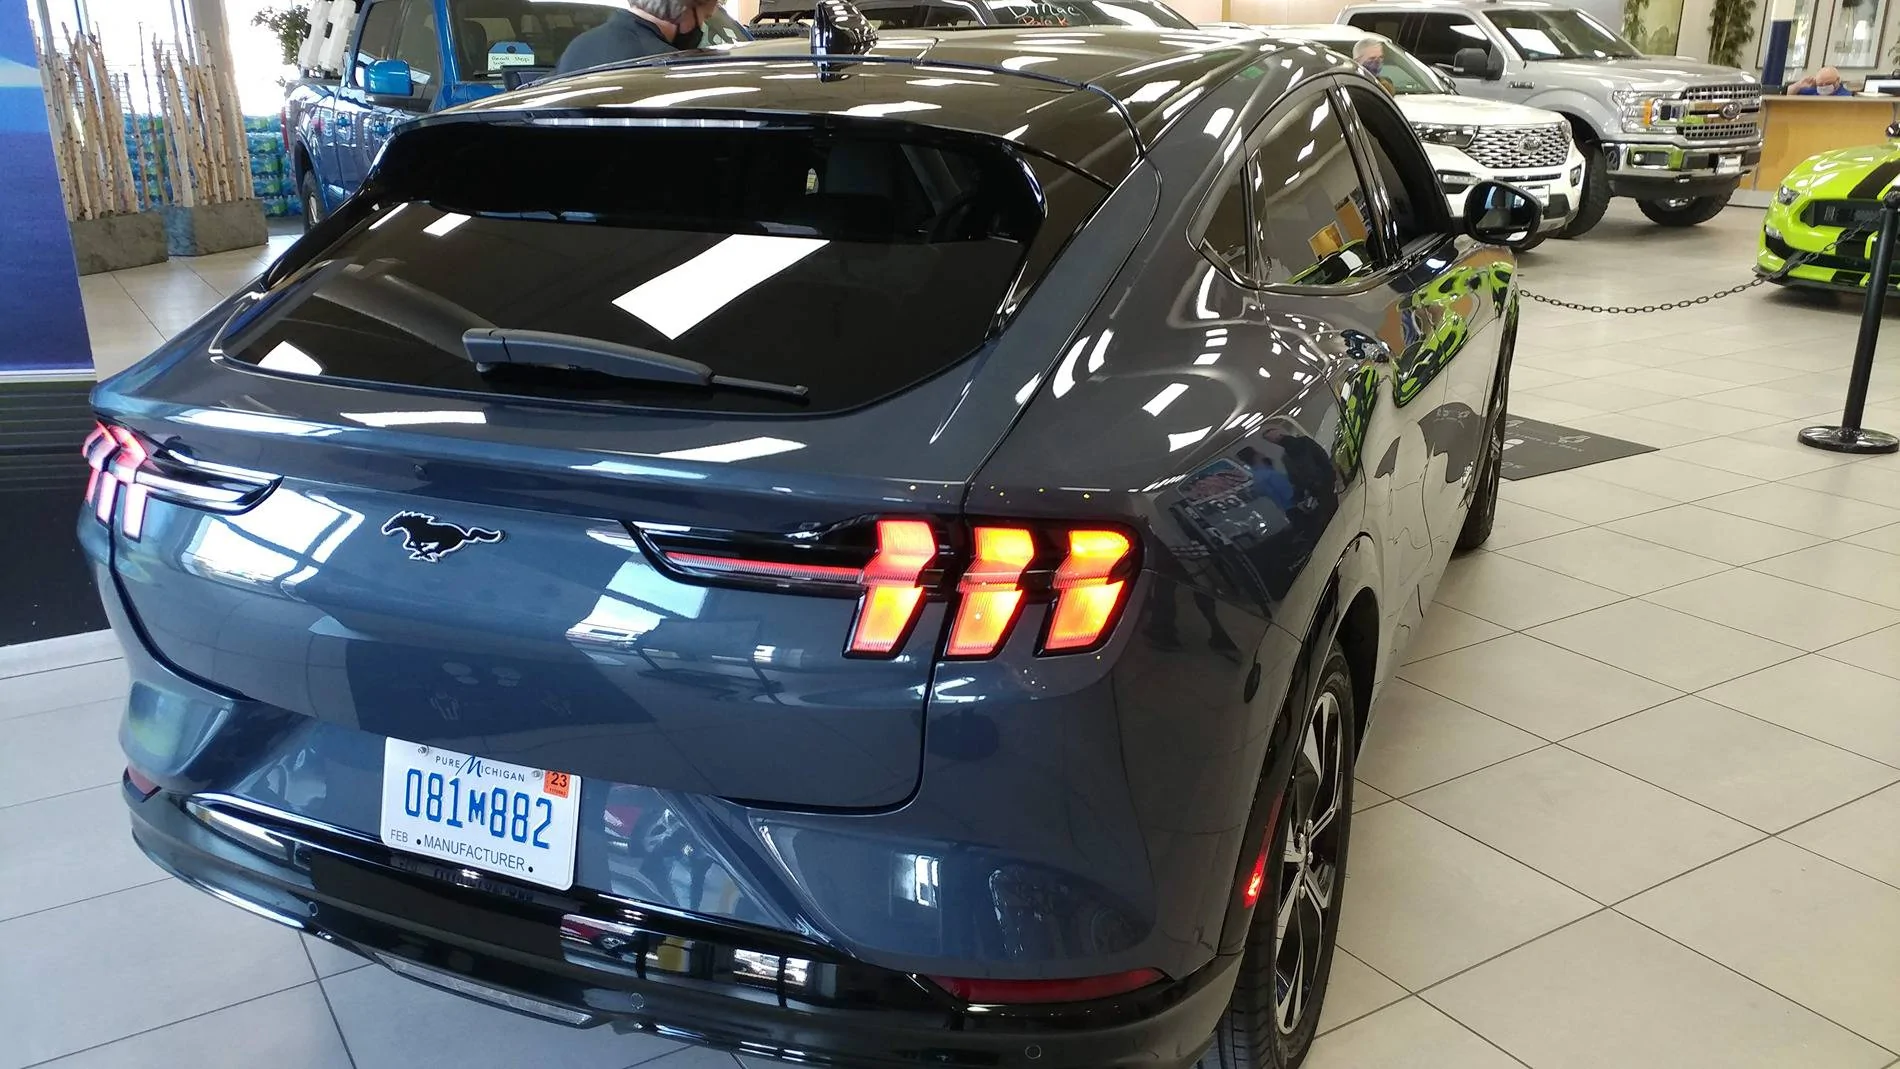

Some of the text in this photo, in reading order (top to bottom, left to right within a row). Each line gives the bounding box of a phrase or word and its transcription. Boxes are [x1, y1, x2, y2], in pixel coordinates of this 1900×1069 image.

[435, 755, 525, 783] PURE MICHIGAN
[551, 772, 567, 788] 23
[404, 768, 553, 850] 081M882
[390, 829, 409, 843] FEB
[424, 834, 525, 871] MANUFACTURER
